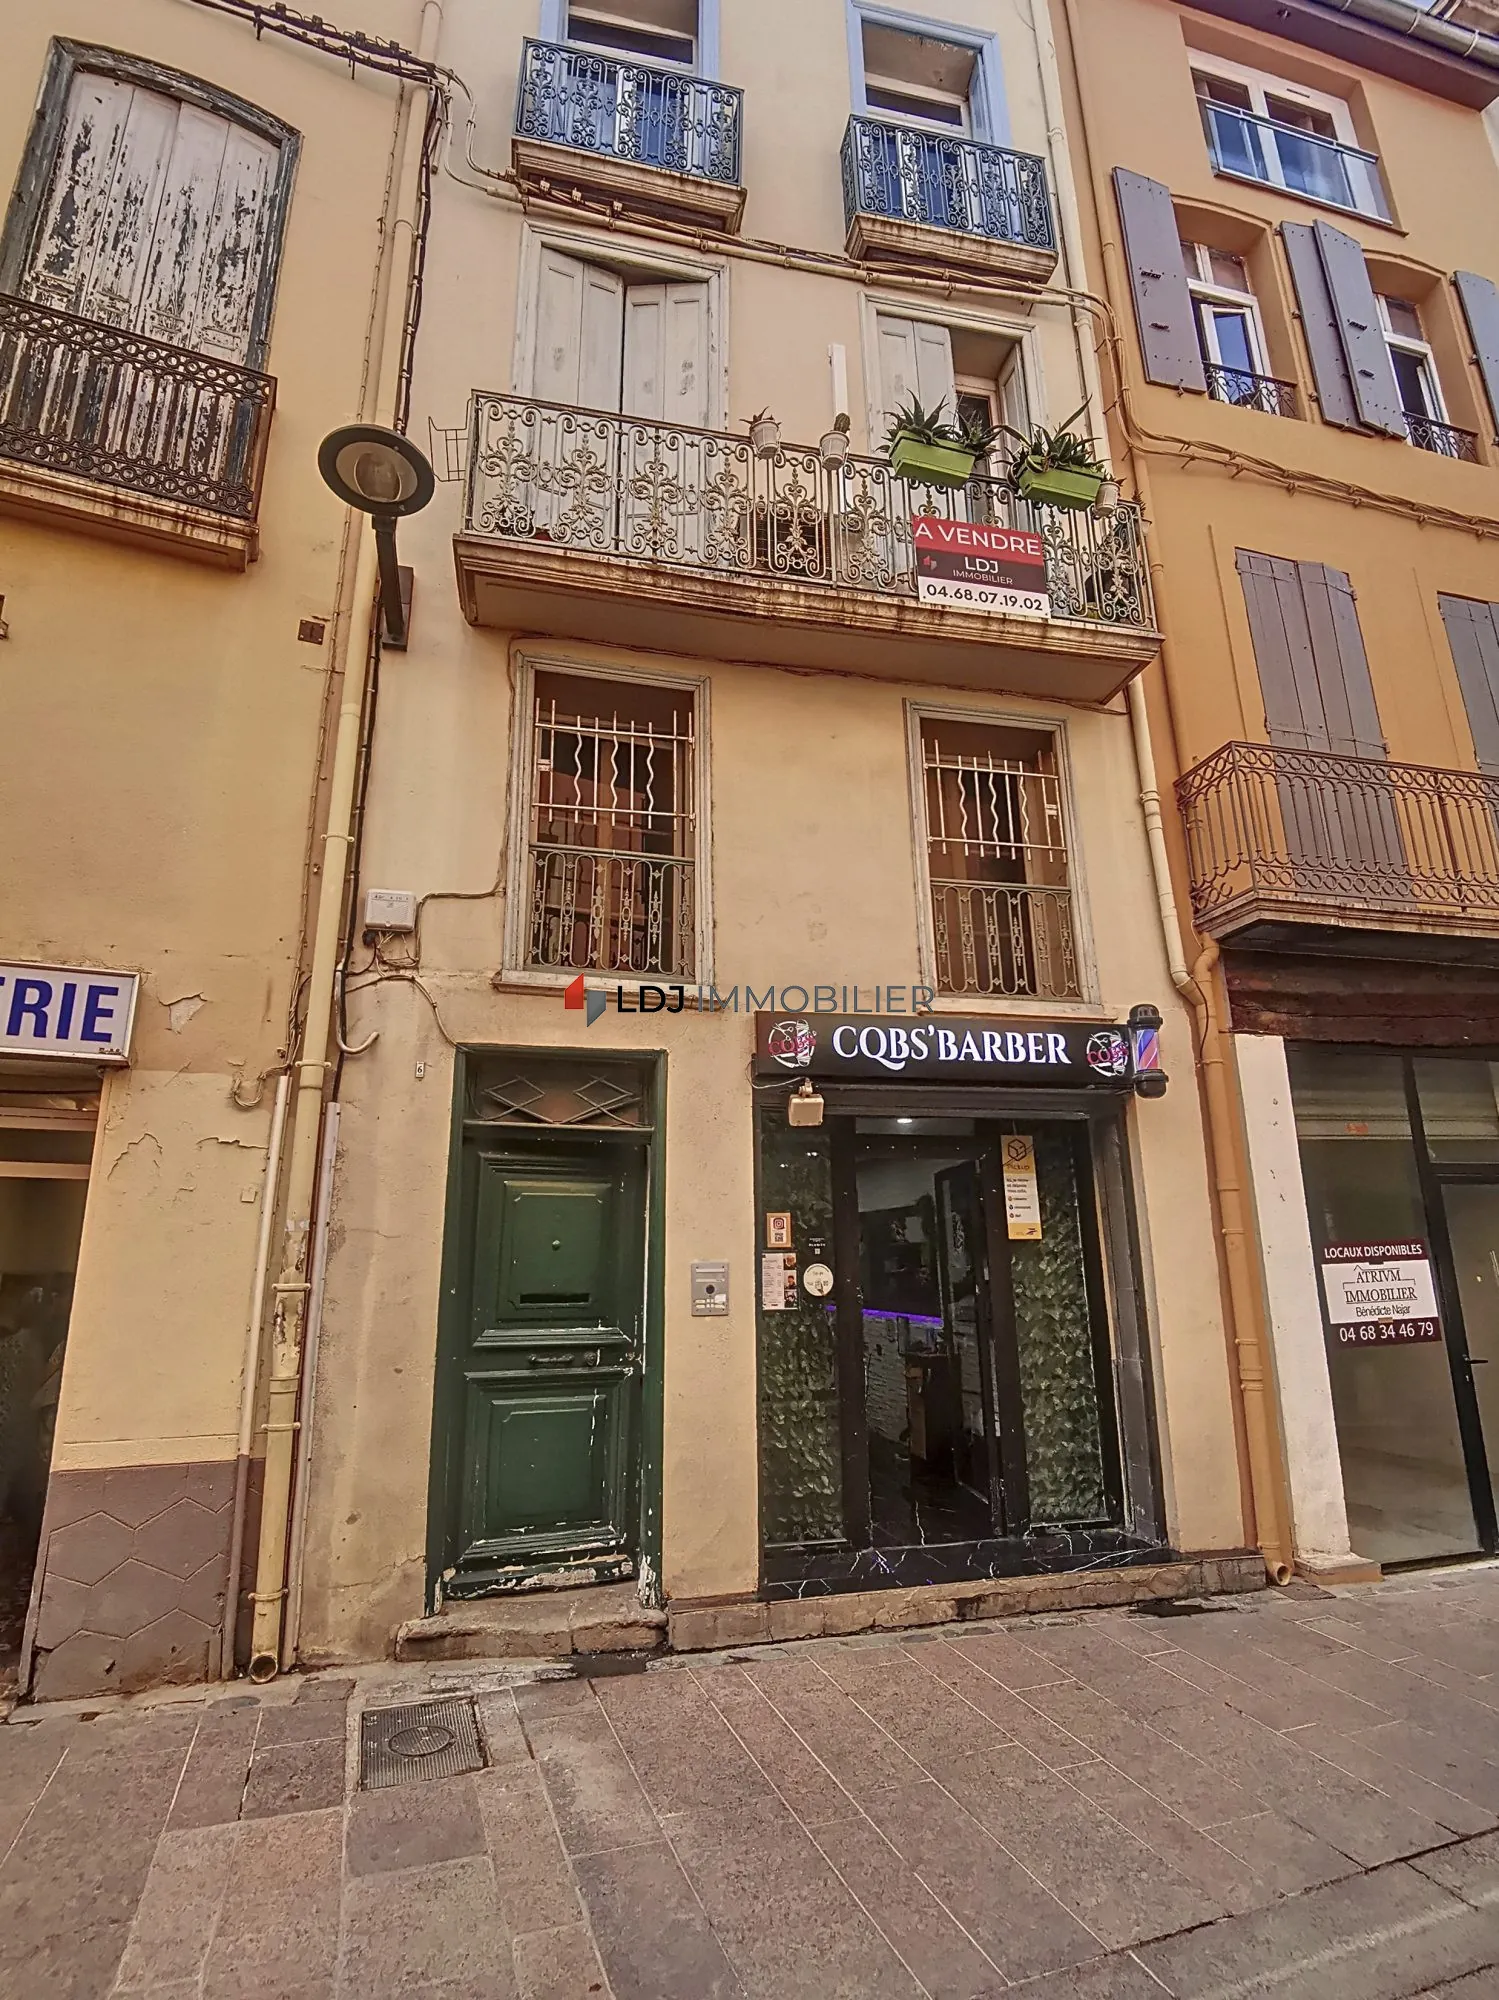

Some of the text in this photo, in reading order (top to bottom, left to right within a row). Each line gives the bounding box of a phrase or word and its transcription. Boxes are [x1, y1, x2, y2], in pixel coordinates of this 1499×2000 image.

[915, 522, 1041, 556] A VENDRE
[964, 556, 999, 574] LDJ
[953, 569, 1013, 585] IMMOBILIER
[926, 584, 1043, 611] 04.68.07.19.02
[0, 976, 119, 1043] RIE
[417, 1065, 423, 1074] 6
[1324, 1244, 1423, 1258] LOCAUX DISPONIBLES
[1344, 1287, 1418, 1303] IMMOBILIER
[1355, 1304, 1411, 1317] Bénédicte Najar
[1340, 1321, 1434, 1342] 04 68 34 46 79
